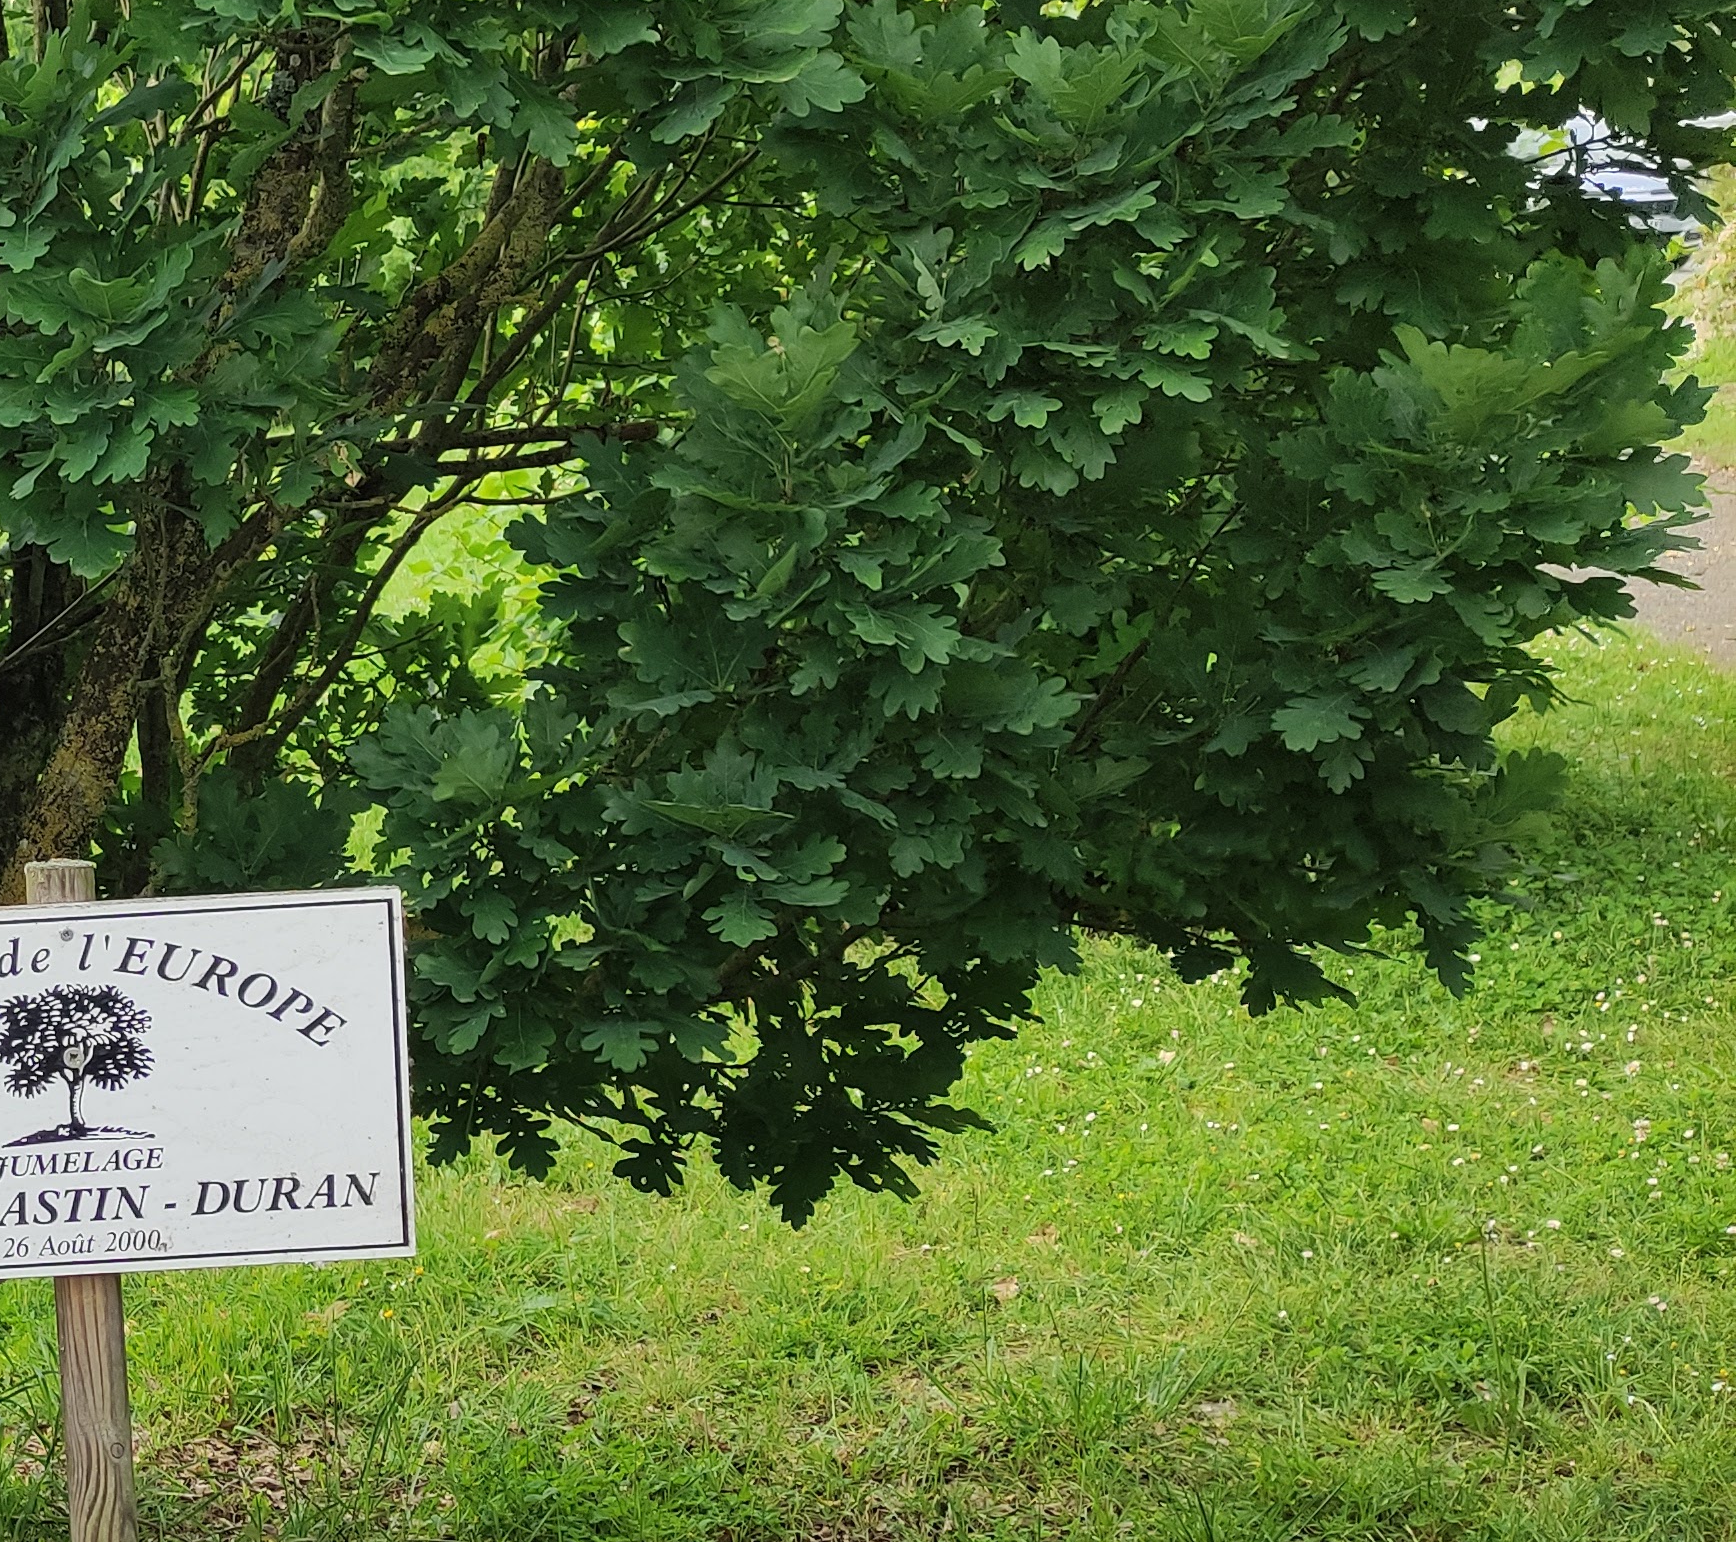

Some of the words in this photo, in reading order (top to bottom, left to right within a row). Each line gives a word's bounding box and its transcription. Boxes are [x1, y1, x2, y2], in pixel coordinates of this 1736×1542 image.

[76, 933, 348, 1049] l'EUROPE
[191, 1172, 381, 1216] DURAN
[3, 1237, 29, 1259] 26
[38, 1235, 95, 1256] Août
[103, 1229, 162, 1254] 2000
